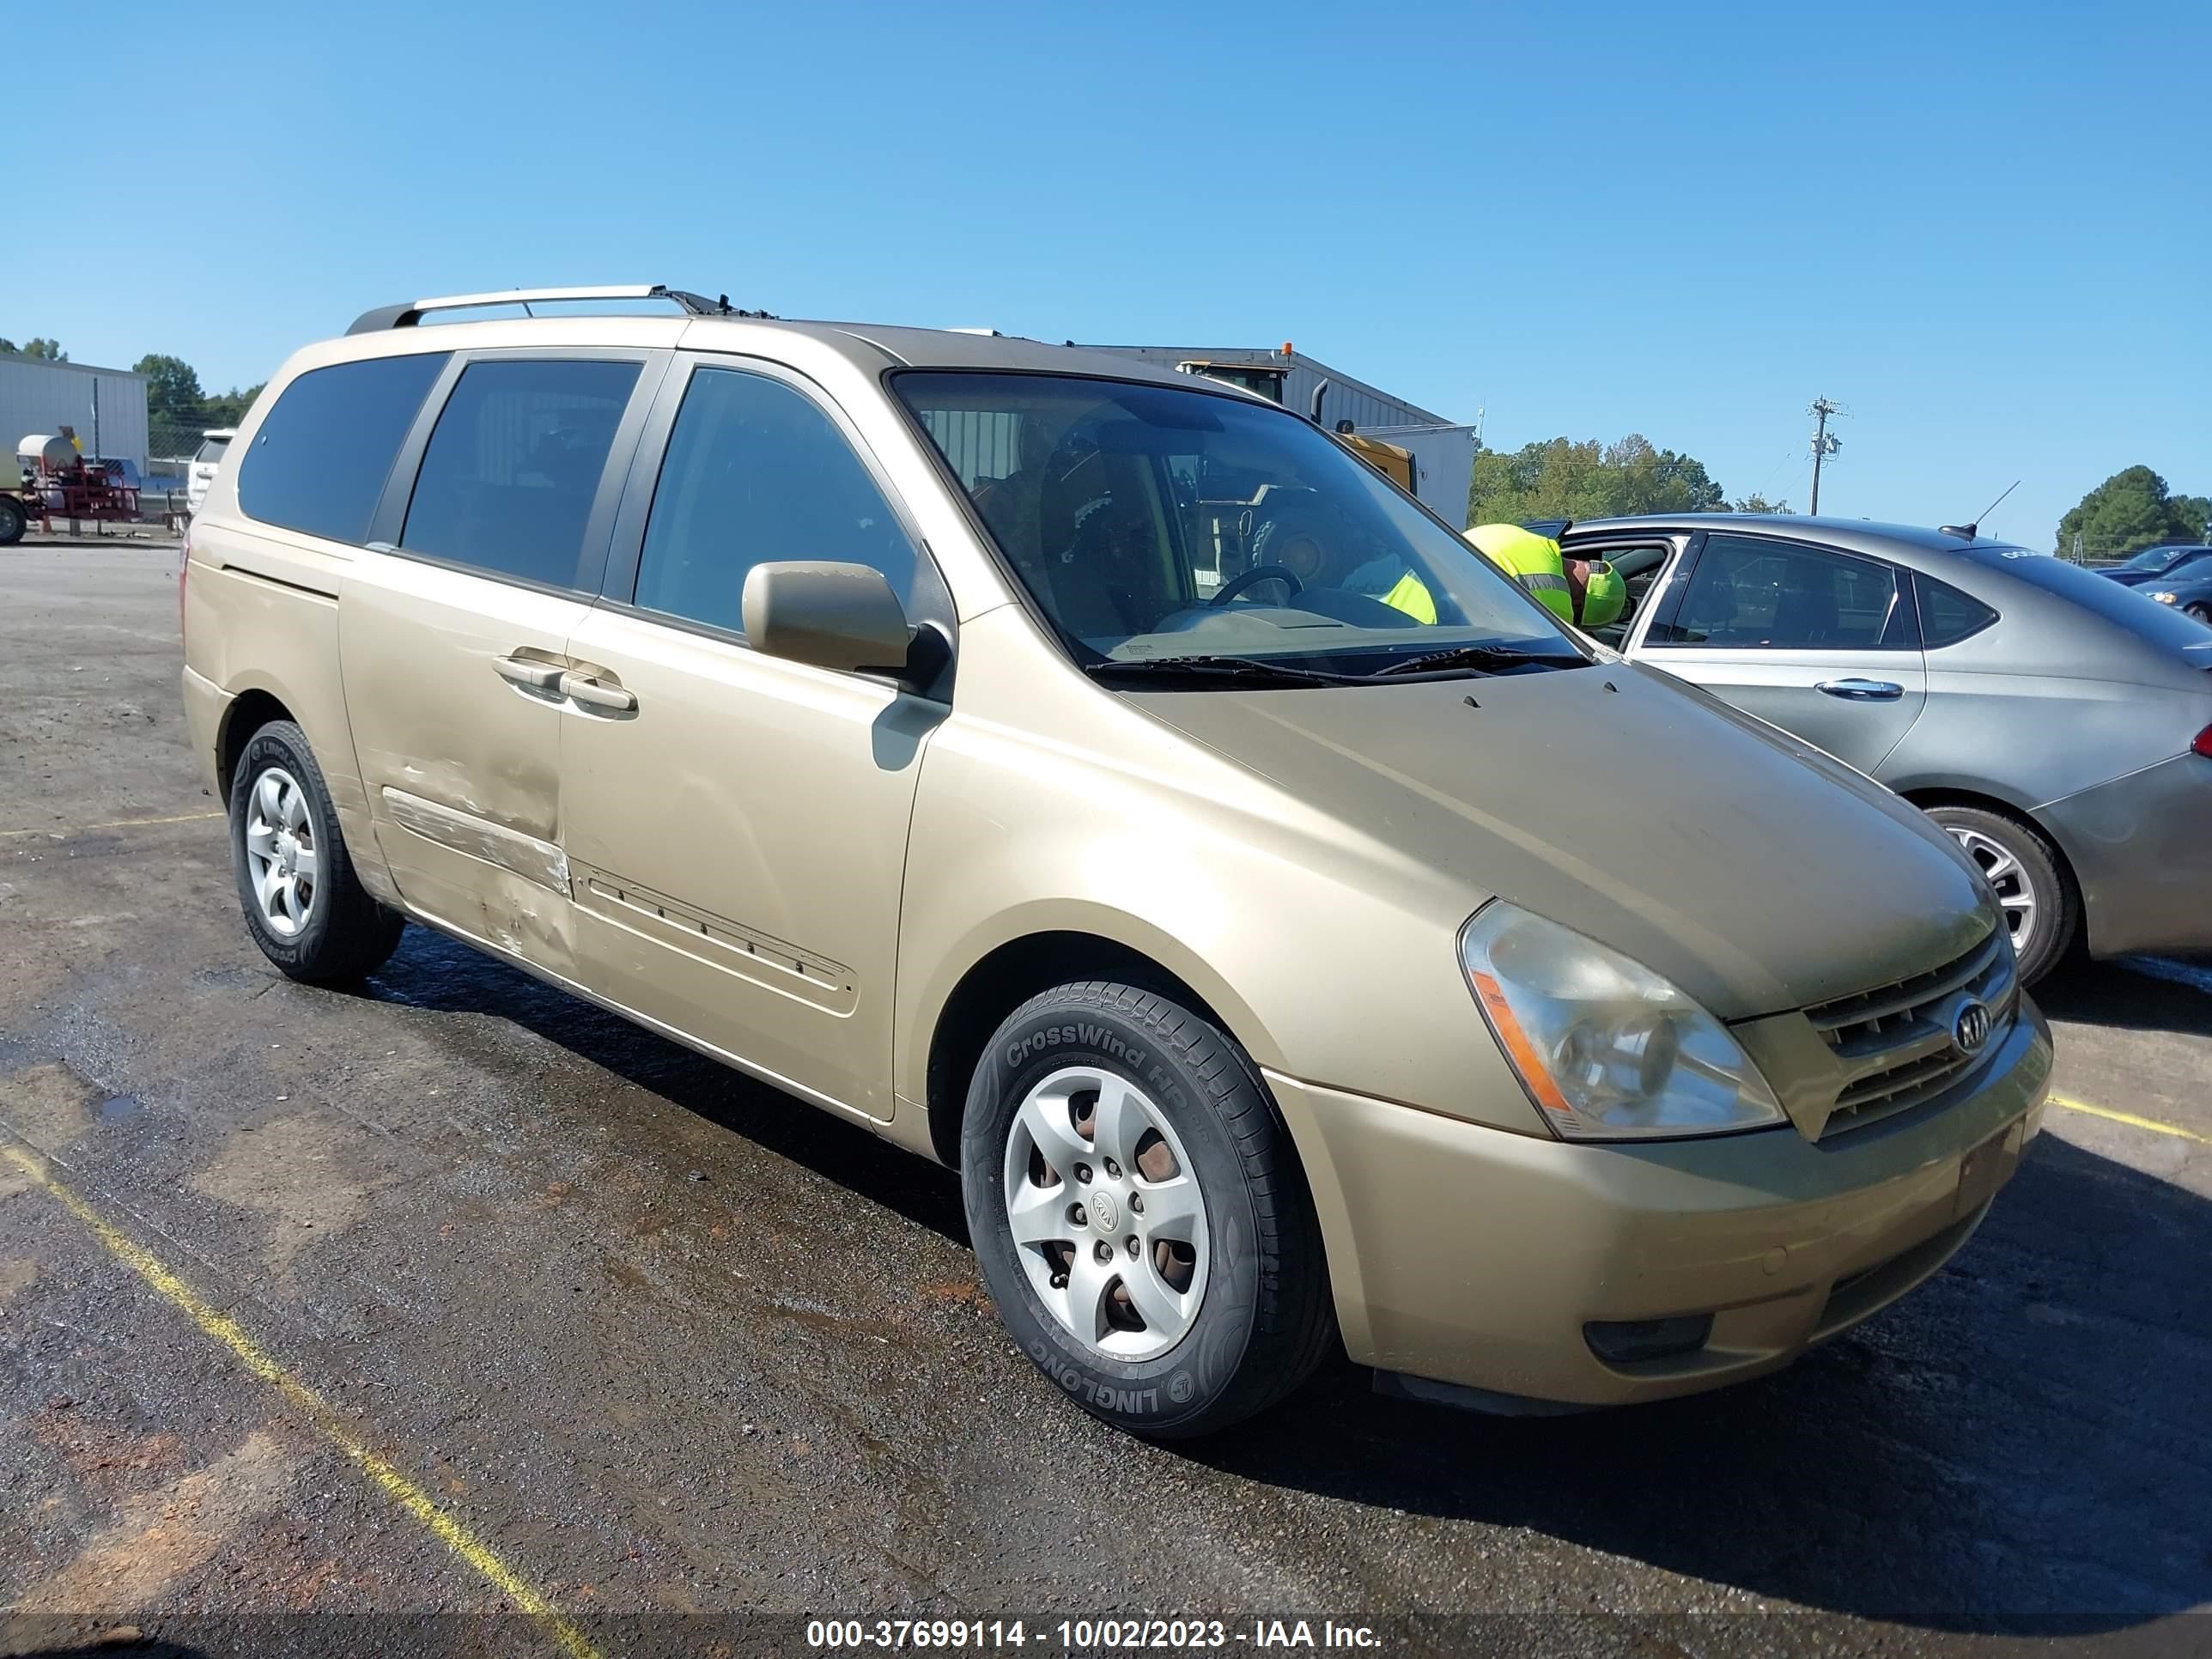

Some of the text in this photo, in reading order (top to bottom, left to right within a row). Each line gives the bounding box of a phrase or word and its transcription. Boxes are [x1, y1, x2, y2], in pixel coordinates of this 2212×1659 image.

[1006, 1022, 1147, 1069] CrossWind
[1958, 1007, 1990, 1048] KIA
[1028, 1337, 1159, 1414] LINGLONG
